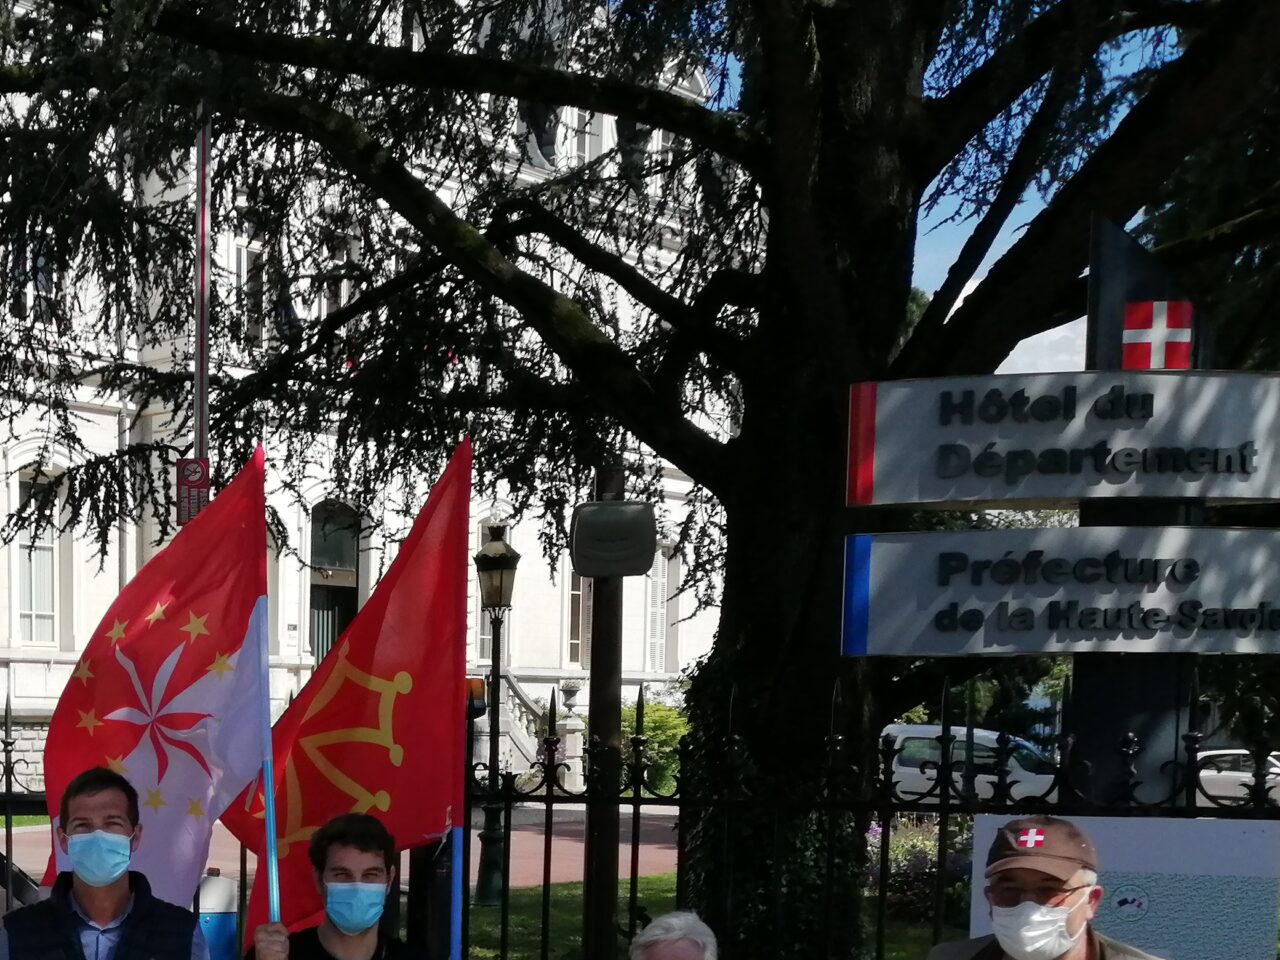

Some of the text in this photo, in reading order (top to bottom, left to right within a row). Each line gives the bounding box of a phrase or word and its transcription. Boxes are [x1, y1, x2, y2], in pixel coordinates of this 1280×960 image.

[938, 385, 1154, 426] Hôtel du
[936, 440, 1258, 484] Département
[937, 549, 1200, 587] Préfecture
[934, 602, 984, 632] de
[997, 601, 1034, 631] la
